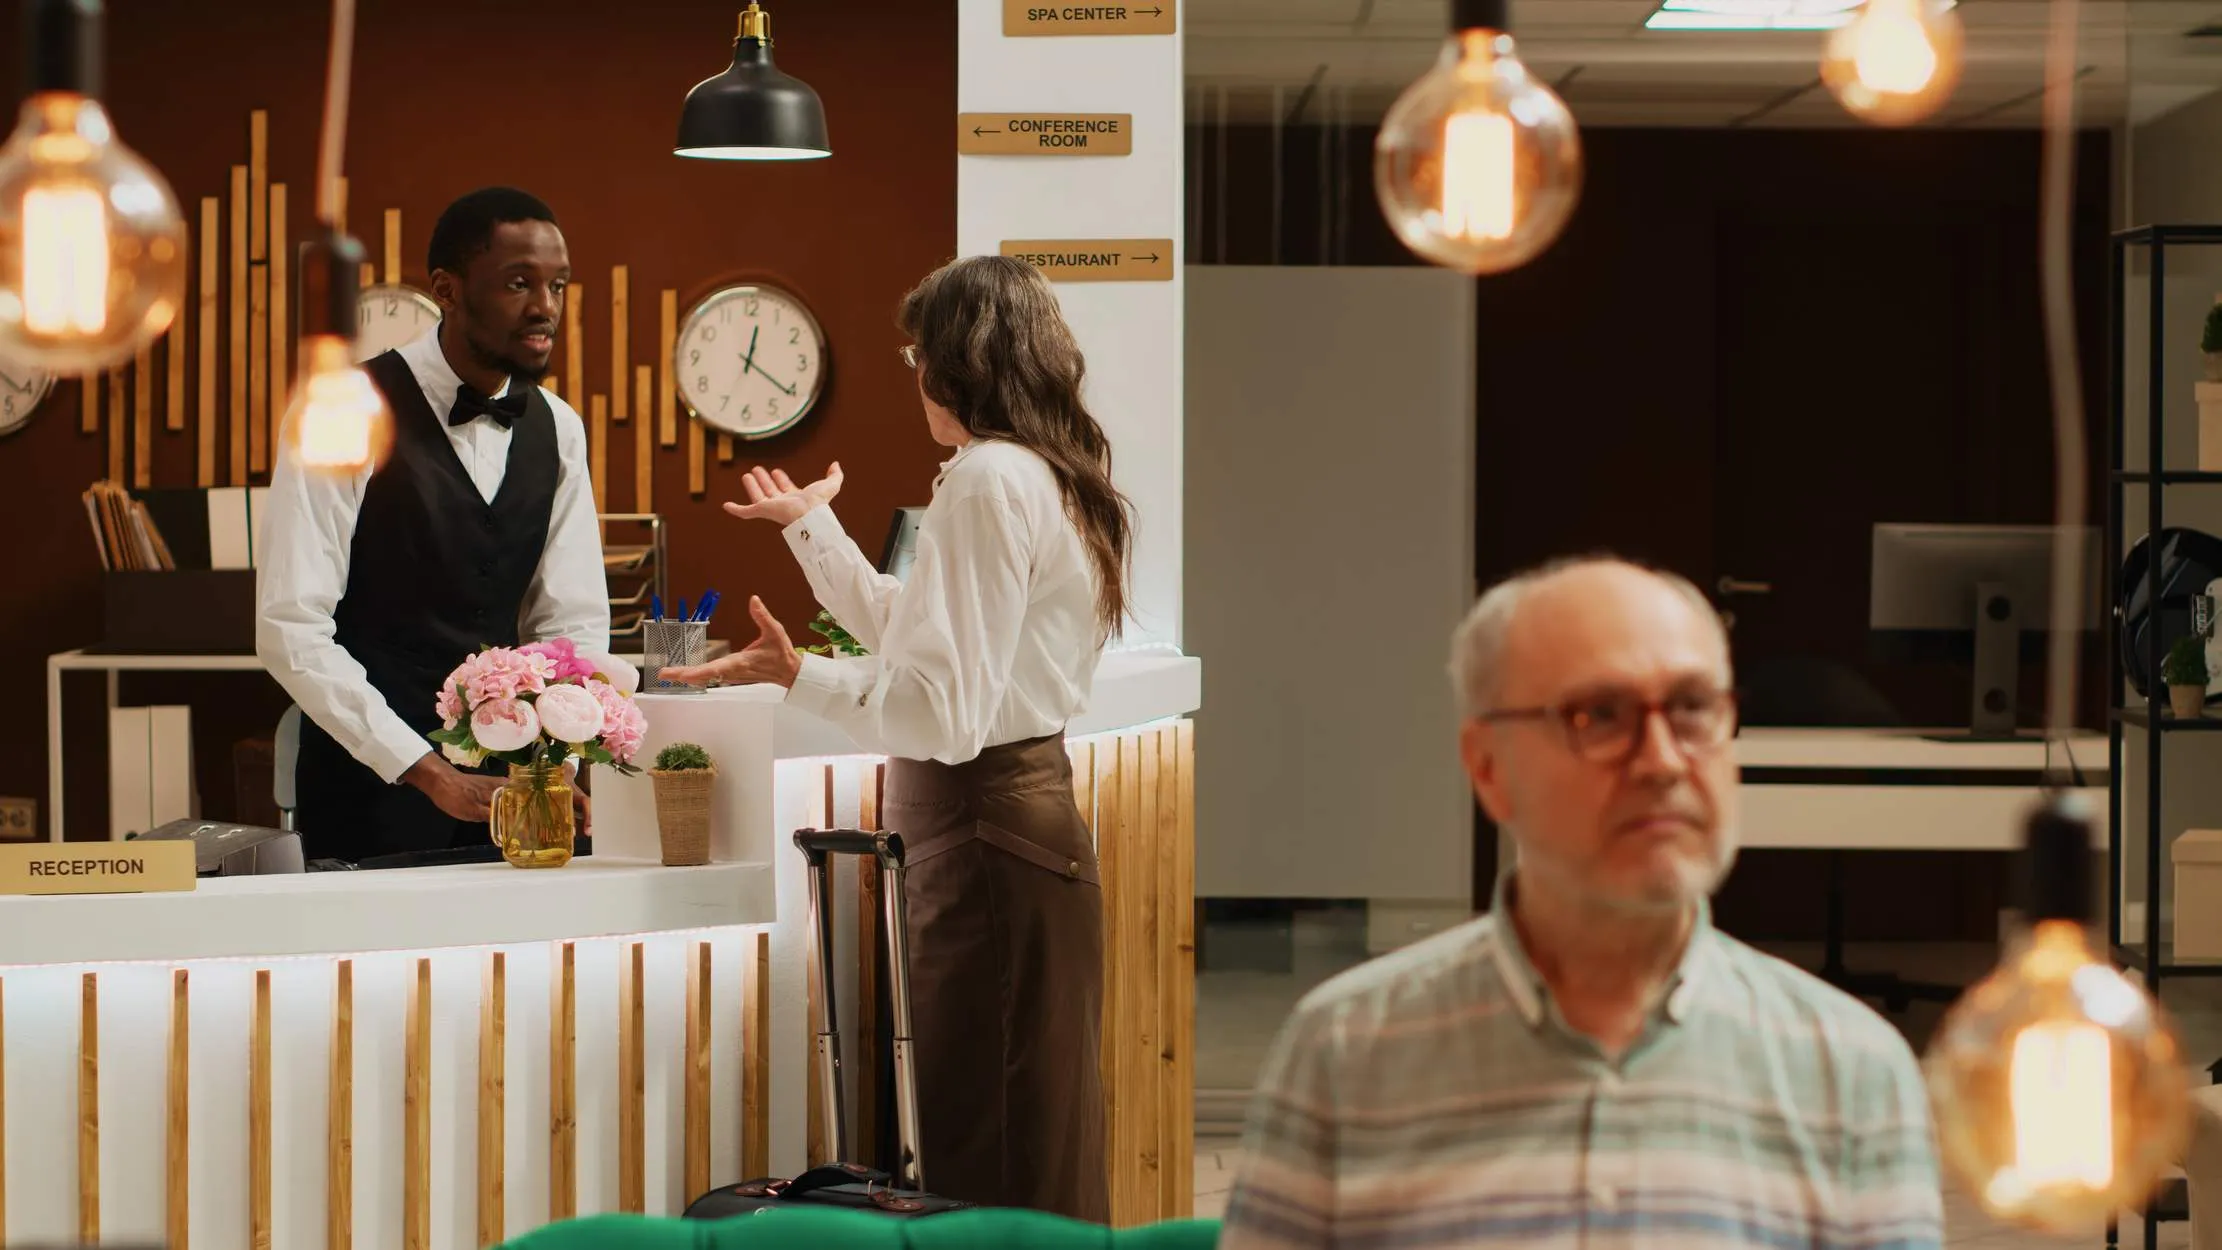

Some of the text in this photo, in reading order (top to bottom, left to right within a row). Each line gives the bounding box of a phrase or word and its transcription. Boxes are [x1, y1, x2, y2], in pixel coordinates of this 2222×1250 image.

[1027, 7, 1127, 21] SPA CENTER
[1008, 120, 1118, 133] CONFERENCE
[1039, 134, 1088, 147] ROOM
[383, 299, 399, 317] 12
[720, 307, 732, 325] 11
[743, 300, 760, 317] 12
[773, 308, 780, 325] 1
[701, 325, 717, 342] 10
[789, 327, 800, 344] 2
[690, 349, 700, 367] 9
[797, 354, 808, 372] 3
[697, 376, 709, 393] 8
[720, 394, 730, 412] 7
[767, 398, 779, 416] 5
[741, 404, 752, 421] 6
[29, 859, 144, 876] RECEPTION
